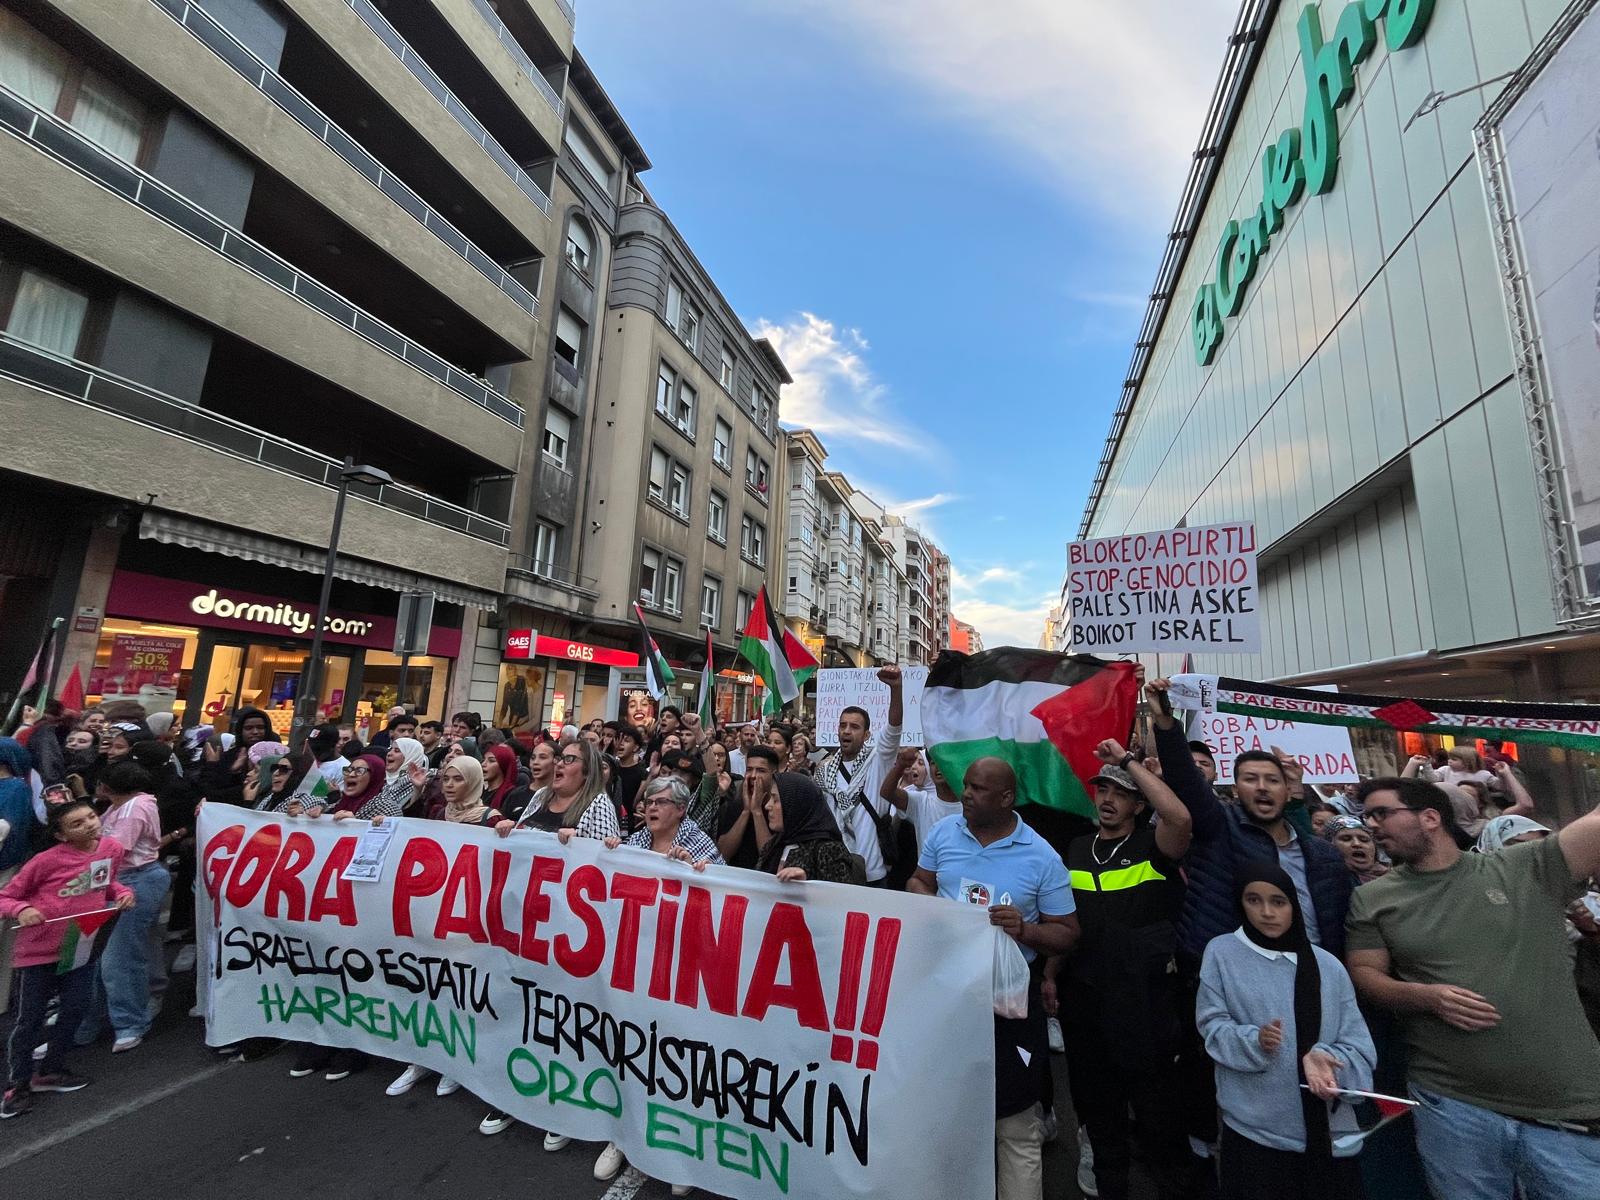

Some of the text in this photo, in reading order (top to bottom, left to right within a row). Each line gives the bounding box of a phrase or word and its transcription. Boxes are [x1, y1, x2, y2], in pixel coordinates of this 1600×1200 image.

[1192, 283, 1224, 366] El
[1216, 127, 1306, 318] Corte
[1072, 587, 1254, 617] PALESTINA ASKE
[508, 637, 530, 646] GAES
[1073, 618, 1244, 645] BOIKOT ISRAEL
[567, 644, 594, 661] GAES
[1233, 693, 1348, 715] PALESTINE
[203, 823, 358, 927] GORA
[376, 948, 499, 1020] ESTATU
[257, 983, 790, 1194] HARREMAN ORO ETEN
